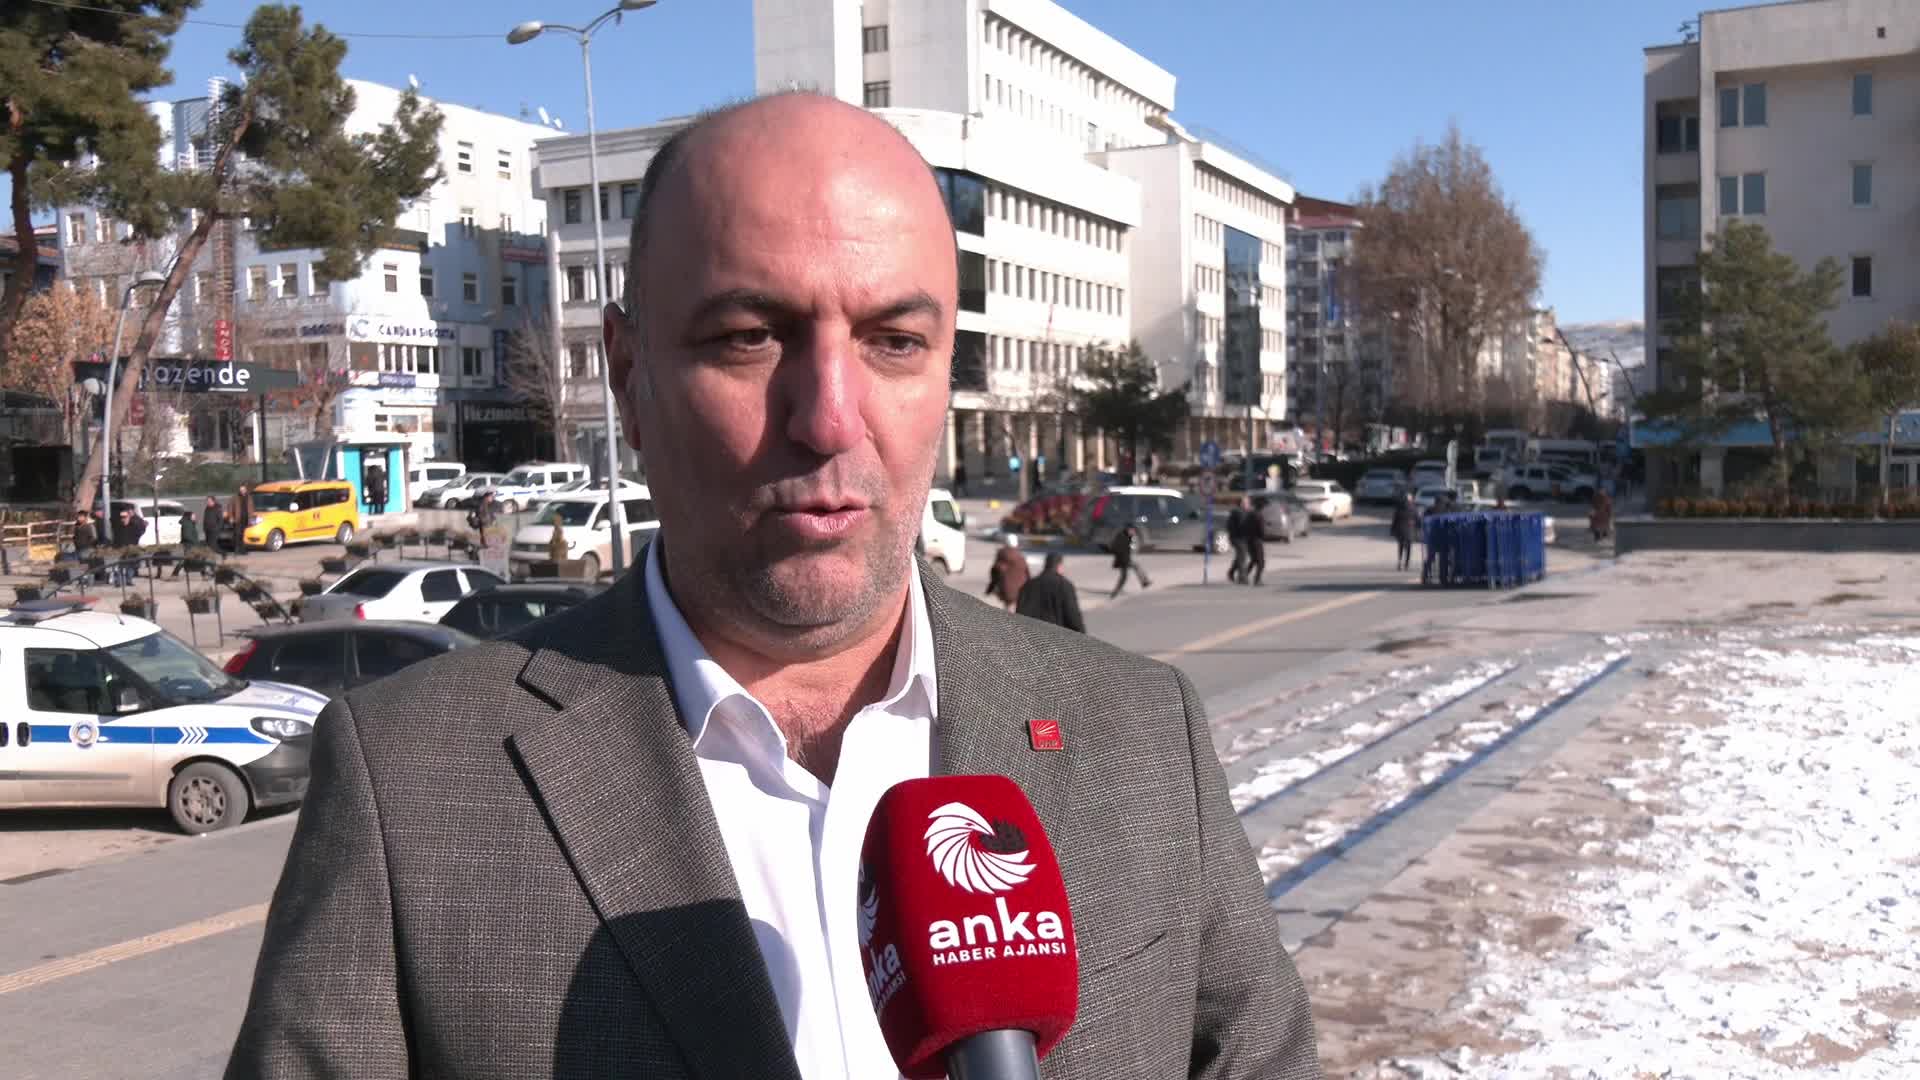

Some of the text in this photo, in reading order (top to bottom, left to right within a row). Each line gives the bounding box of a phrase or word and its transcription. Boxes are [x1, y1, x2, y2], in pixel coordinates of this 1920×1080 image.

[928, 896, 1065, 950] anka
[932, 942, 1067, 966] HABER AJANSI
